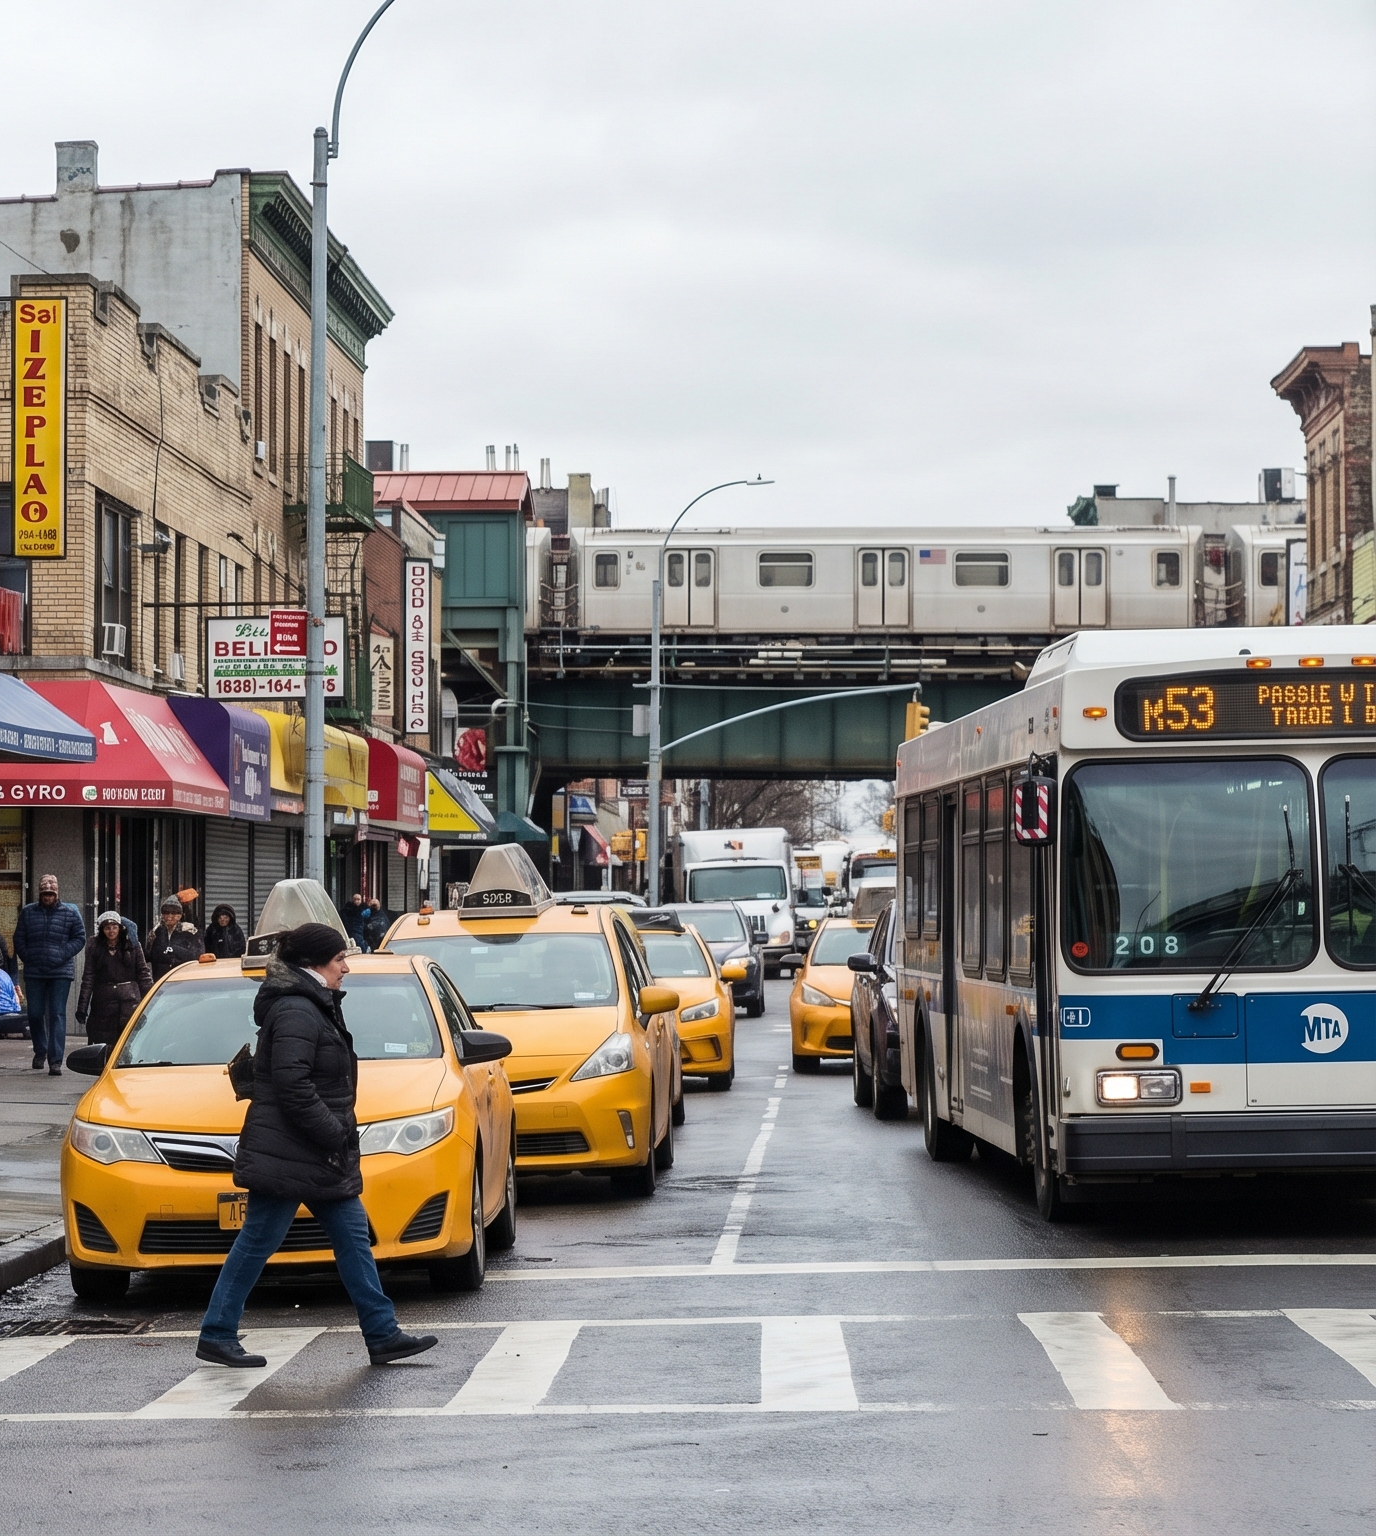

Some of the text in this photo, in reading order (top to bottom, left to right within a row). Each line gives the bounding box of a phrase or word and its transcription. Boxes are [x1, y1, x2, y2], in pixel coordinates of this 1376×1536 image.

[1143, 686, 1215, 731] M53
[10, 785, 66, 799] GYRO
[1302, 1014, 1342, 1044] MTA
